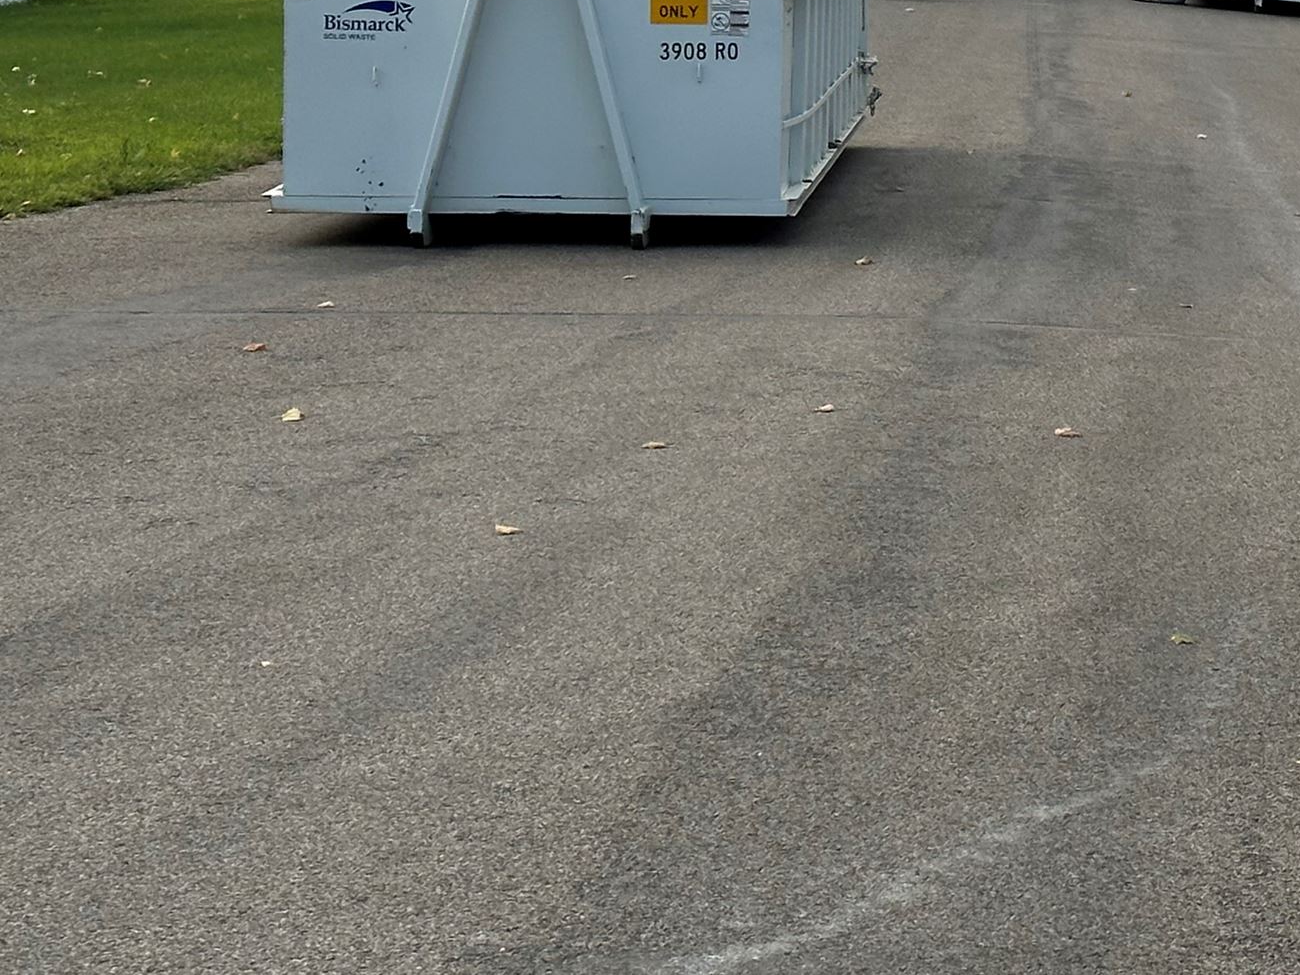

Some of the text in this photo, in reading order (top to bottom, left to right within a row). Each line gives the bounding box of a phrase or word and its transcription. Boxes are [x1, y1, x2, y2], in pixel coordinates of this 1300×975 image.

[659, 5, 699, 18] ONLY
[323, 14, 406, 32] Bismarck
[349, 33, 376, 41] WASTE
[660, 42, 707, 61] 3908
